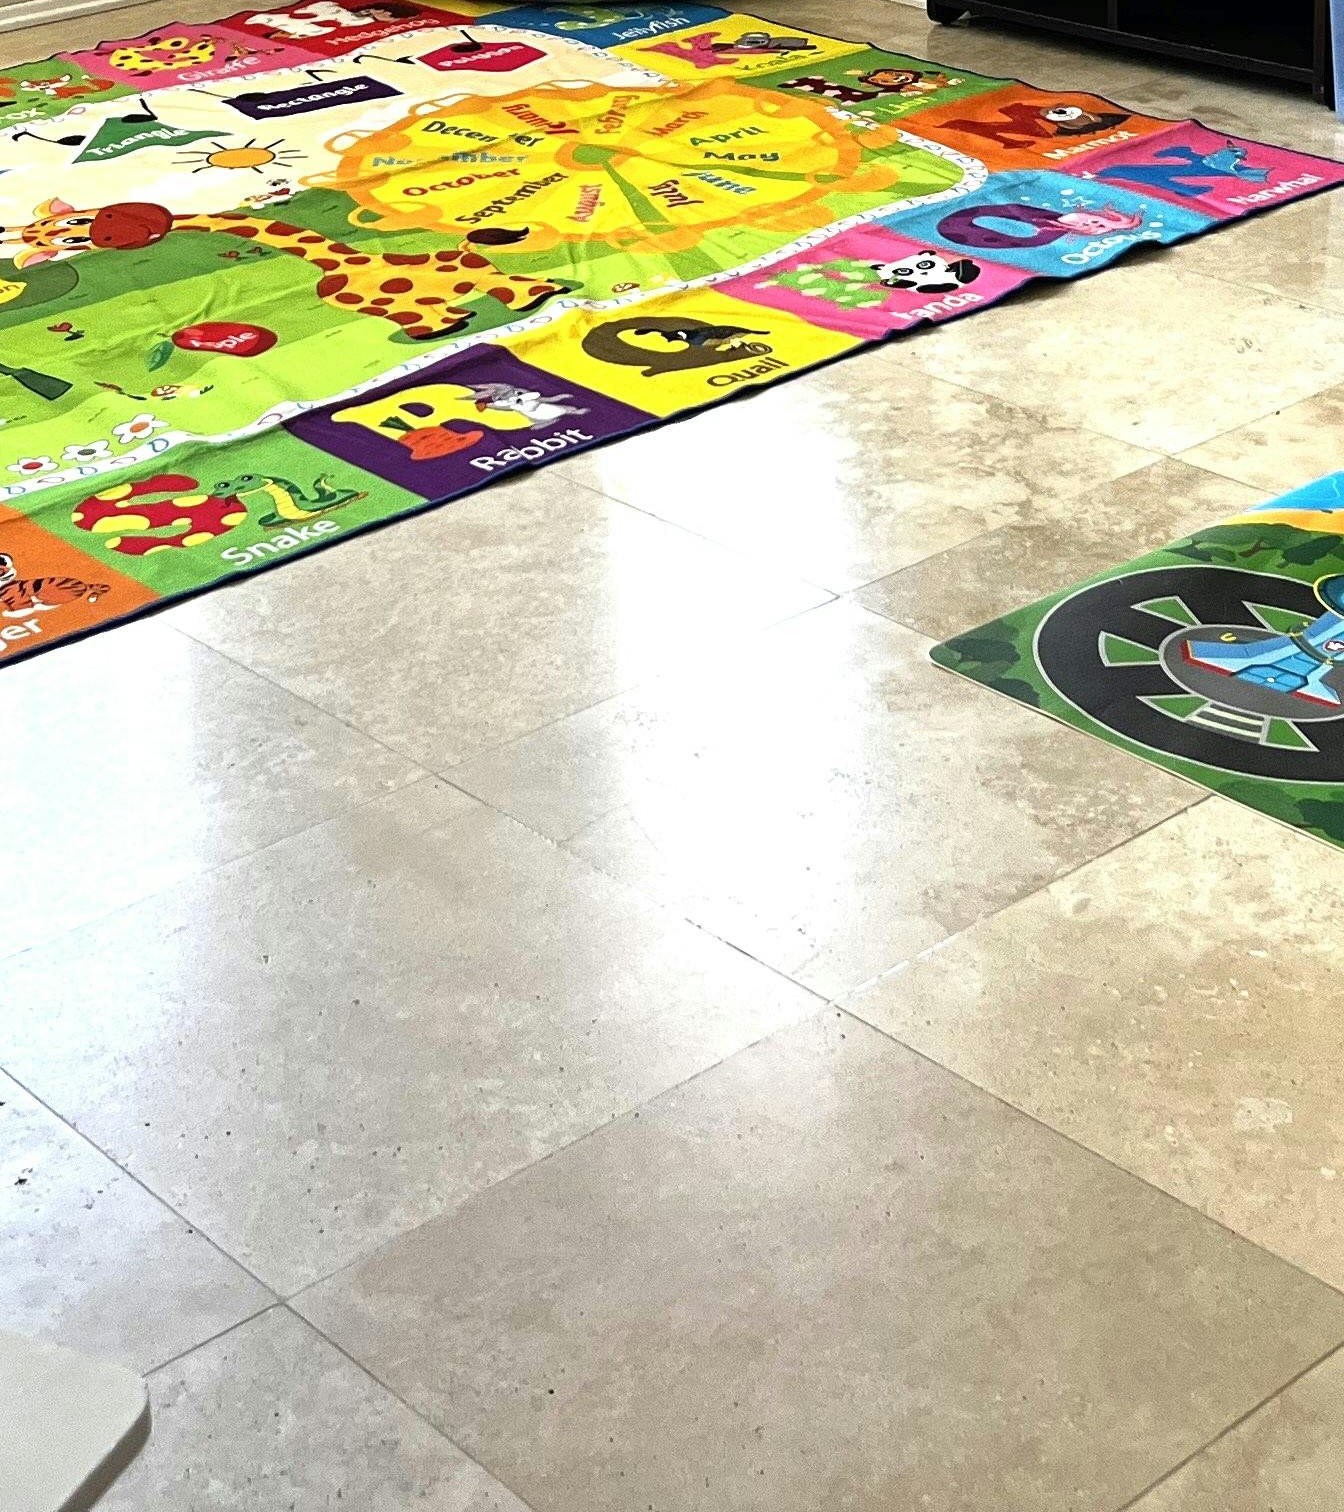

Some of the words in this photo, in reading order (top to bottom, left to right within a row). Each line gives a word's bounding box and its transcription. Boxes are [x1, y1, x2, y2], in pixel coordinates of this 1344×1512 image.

[325, 17, 440, 45] Hedgehog
[609, 15, 690, 41] Jellyfish
[177, 54, 262, 84] Giraffe
[258, 80, 370, 111] Rectangle
[642, 111, 709, 137] March
[690, 127, 769, 147] April
[85, 126, 187, 159] Triangle
[703, 152, 780, 162] May
[1043, 129, 1139, 162] Marmot
[402, 166, 521, 196] October
[648, 179, 704, 207] July
[681, 172, 757, 195] June
[455, 171, 570, 225] September
[566, 183, 605, 222] August
[704, 353, 791, 389] Quail
[469, 424, 594, 475] Rabbit
[71, 473, 248, 558] S
[220, 513, 341, 569] Snake
